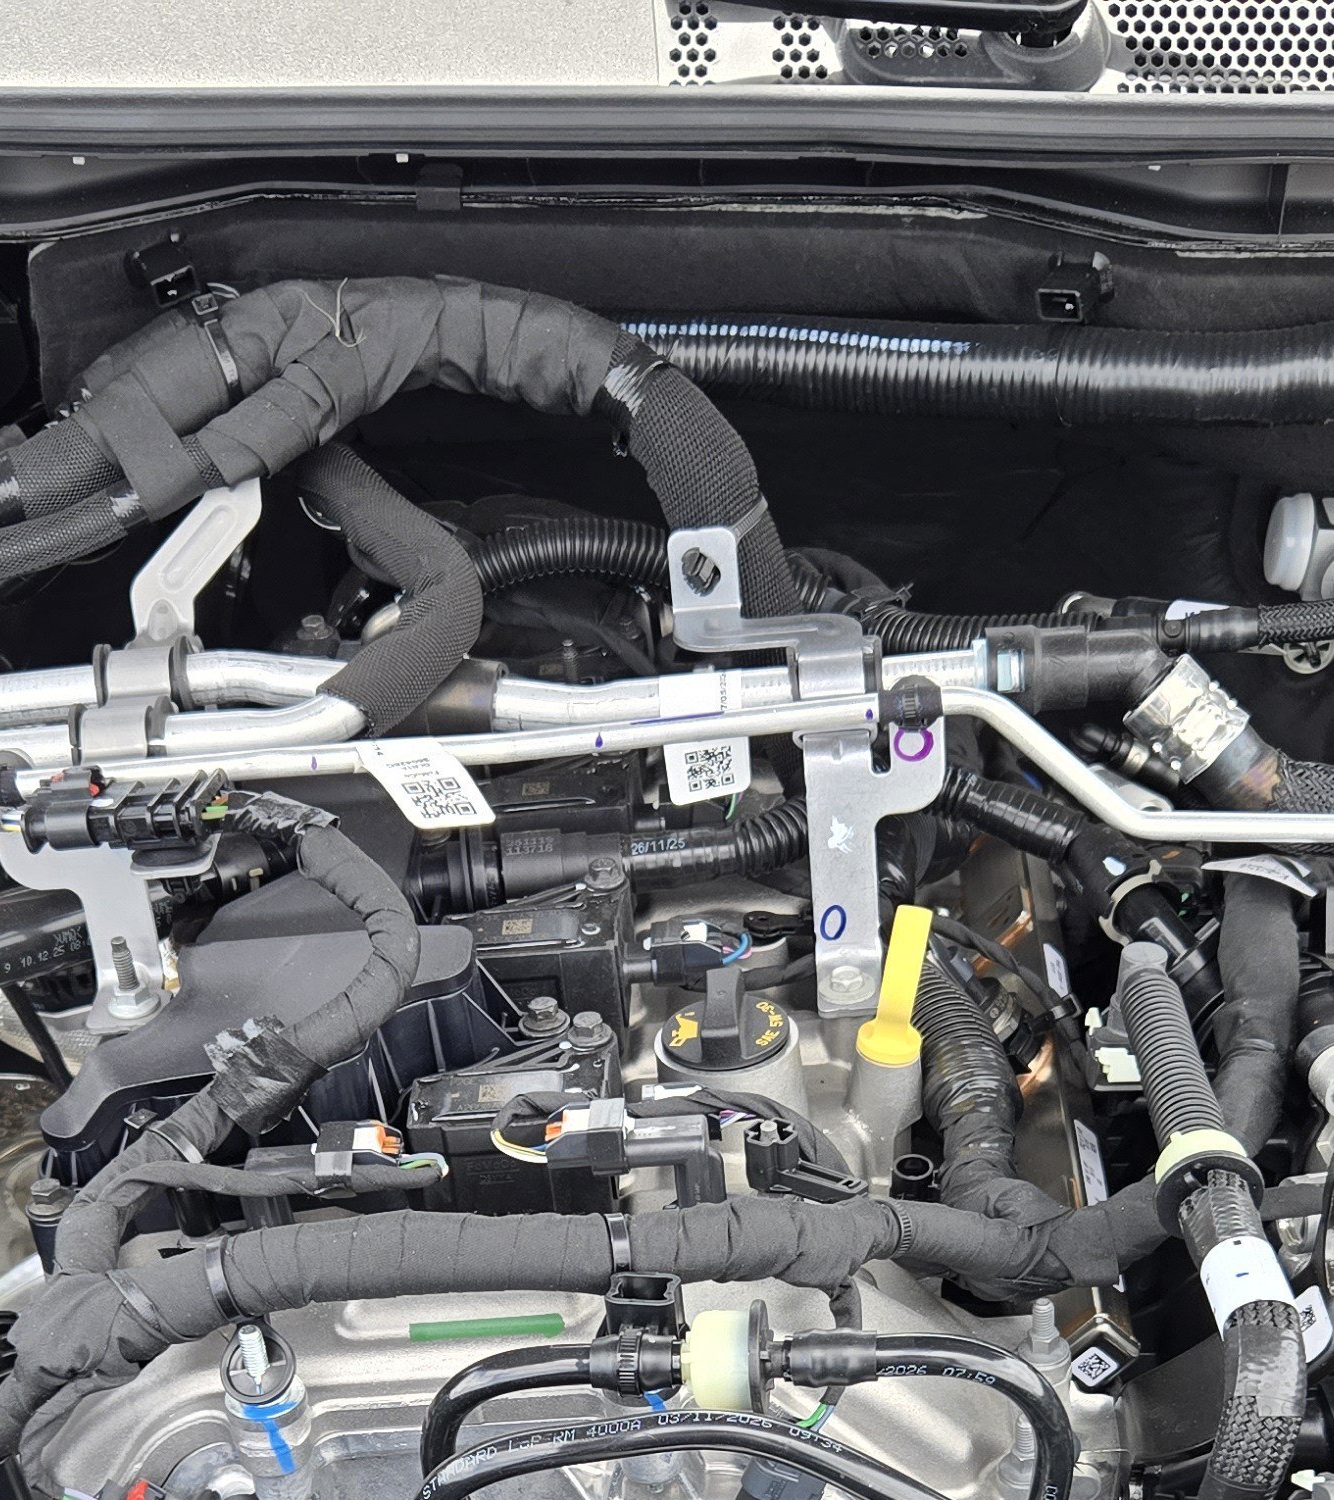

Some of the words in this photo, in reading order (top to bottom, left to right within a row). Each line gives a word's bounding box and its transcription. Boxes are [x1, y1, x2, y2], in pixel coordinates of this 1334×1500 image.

[631, 838, 686, 856] 26/11/25
[755, 1030, 780, 1046] SAE
[942, 1367, 996, 1386] 07:59
[422, 1446, 498, 1500] STANDARD
[586, 1419, 642, 1438] 4000A
[658, 1412, 773, 1429] 03/11/2026
[789, 1426, 843, 1453] 09:34
